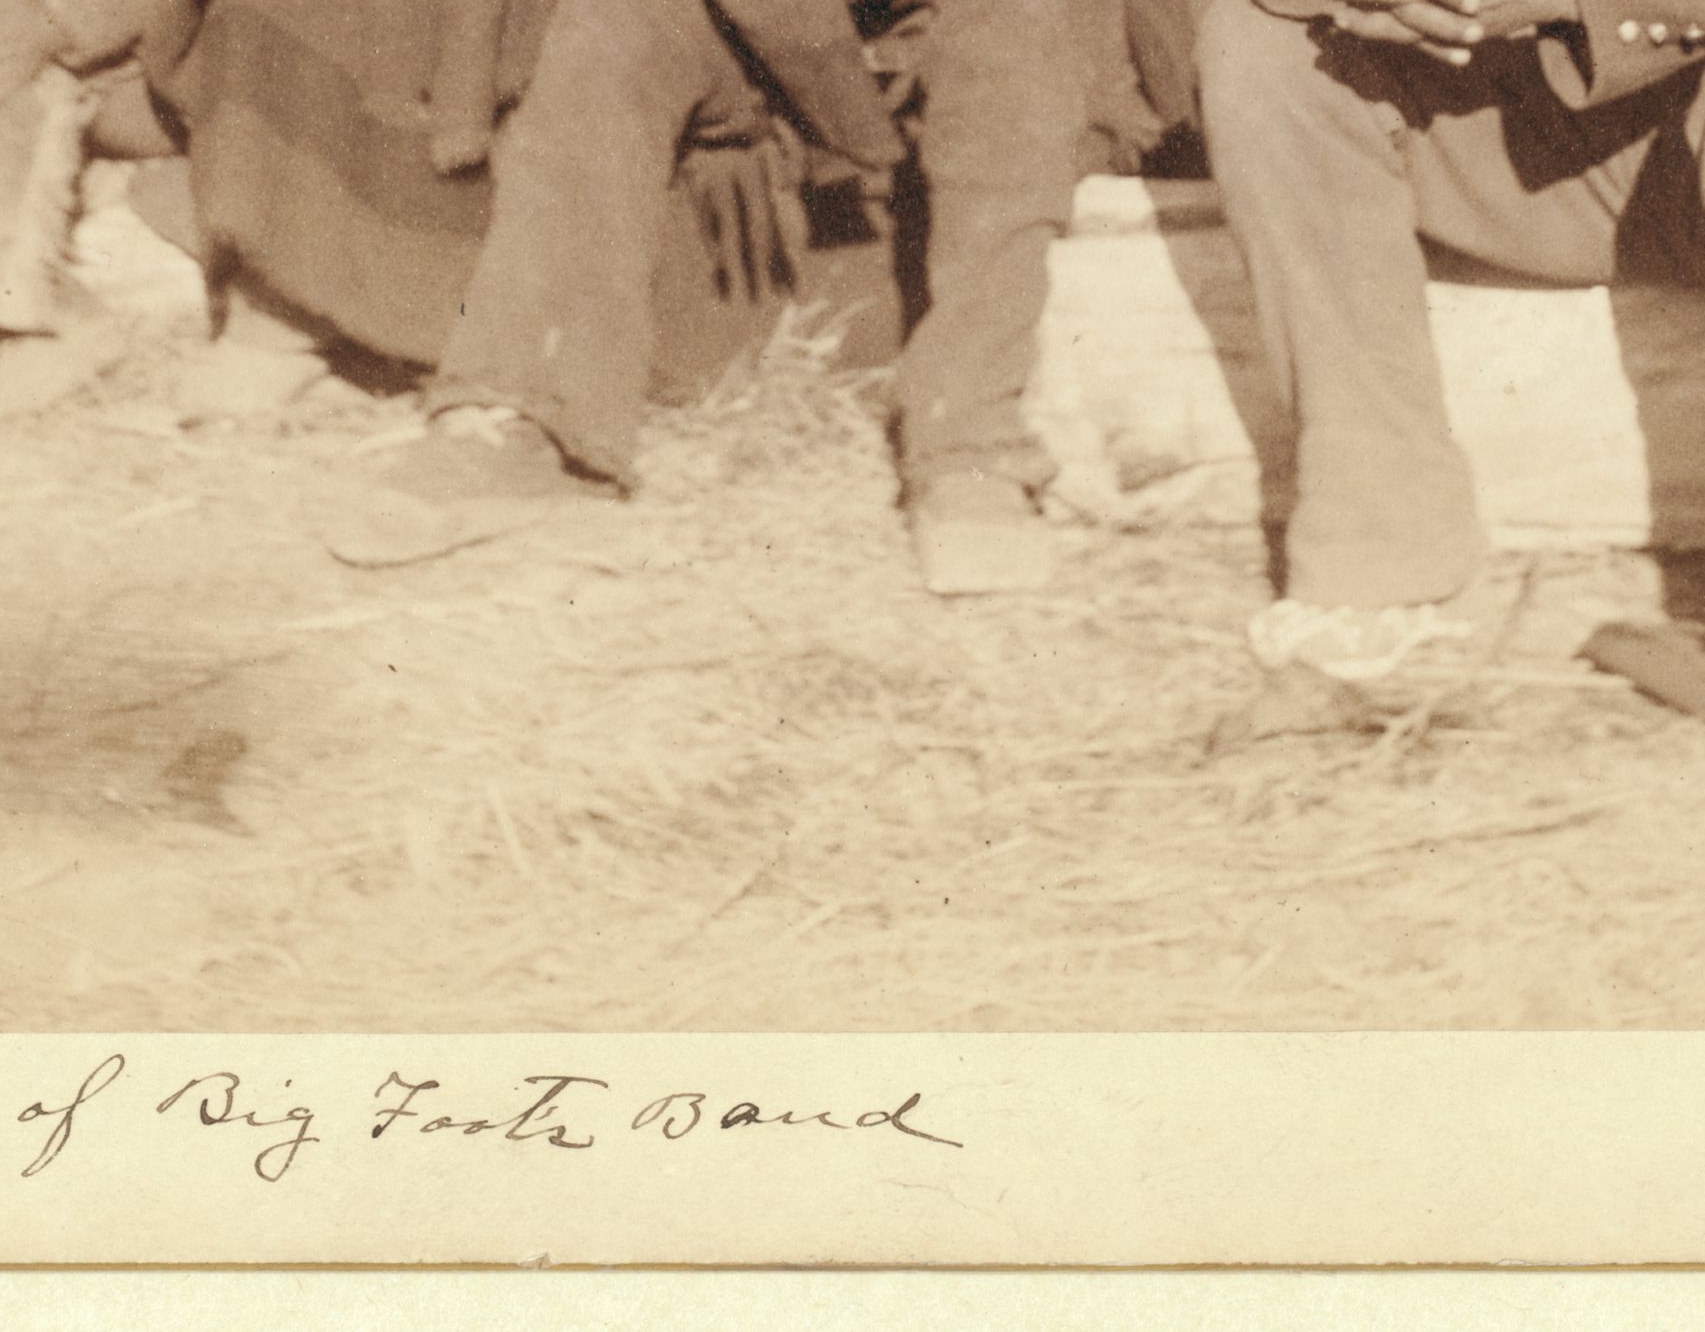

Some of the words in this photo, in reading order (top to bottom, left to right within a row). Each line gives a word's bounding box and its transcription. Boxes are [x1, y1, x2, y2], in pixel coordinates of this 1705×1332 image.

[17, 1053, 126, 1178] of
[156, 1072, 320, 1183] Big
[631, 1092, 964, 1148] Band
